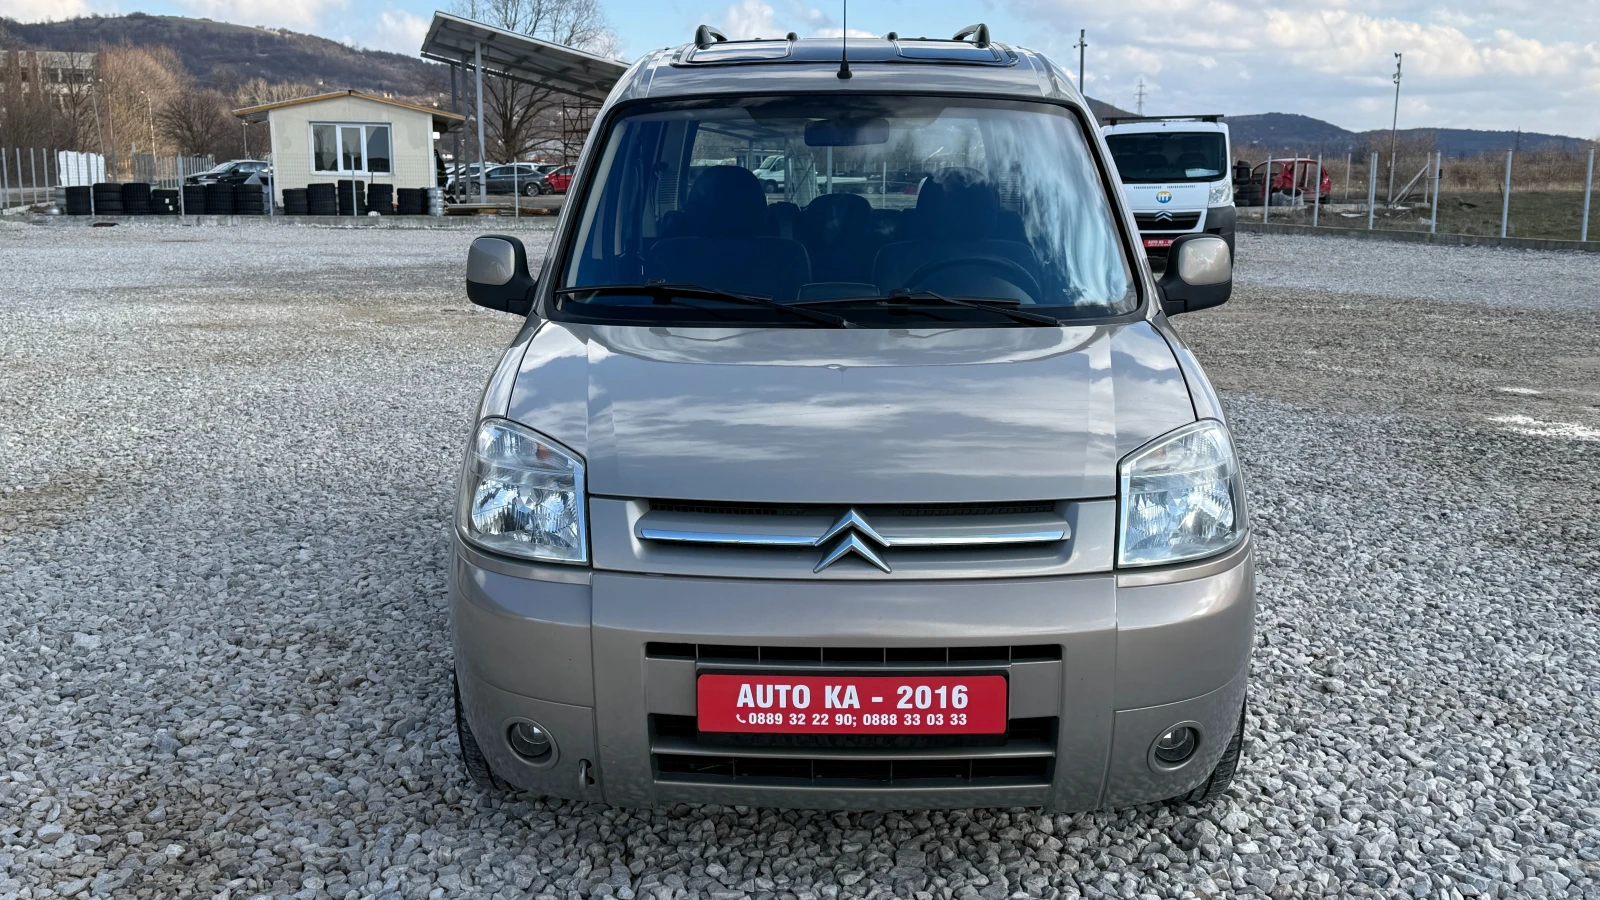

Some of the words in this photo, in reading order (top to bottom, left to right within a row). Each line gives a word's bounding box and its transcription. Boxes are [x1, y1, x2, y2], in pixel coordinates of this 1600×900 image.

[736, 683, 811, 709] AUTO
[824, 684, 861, 709] KA
[896, 685, 968, 710] 2016
[748, 712, 783, 725] 0889
[789, 713, 806, 725] 32
[812, 713, 829, 726] 22
[834, 713, 857, 728] 90;
[862, 713, 898, 726] 0888
[903, 713, 921, 726] 33
[926, 713, 944, 726] 03
[949, 713, 967, 726] 33
